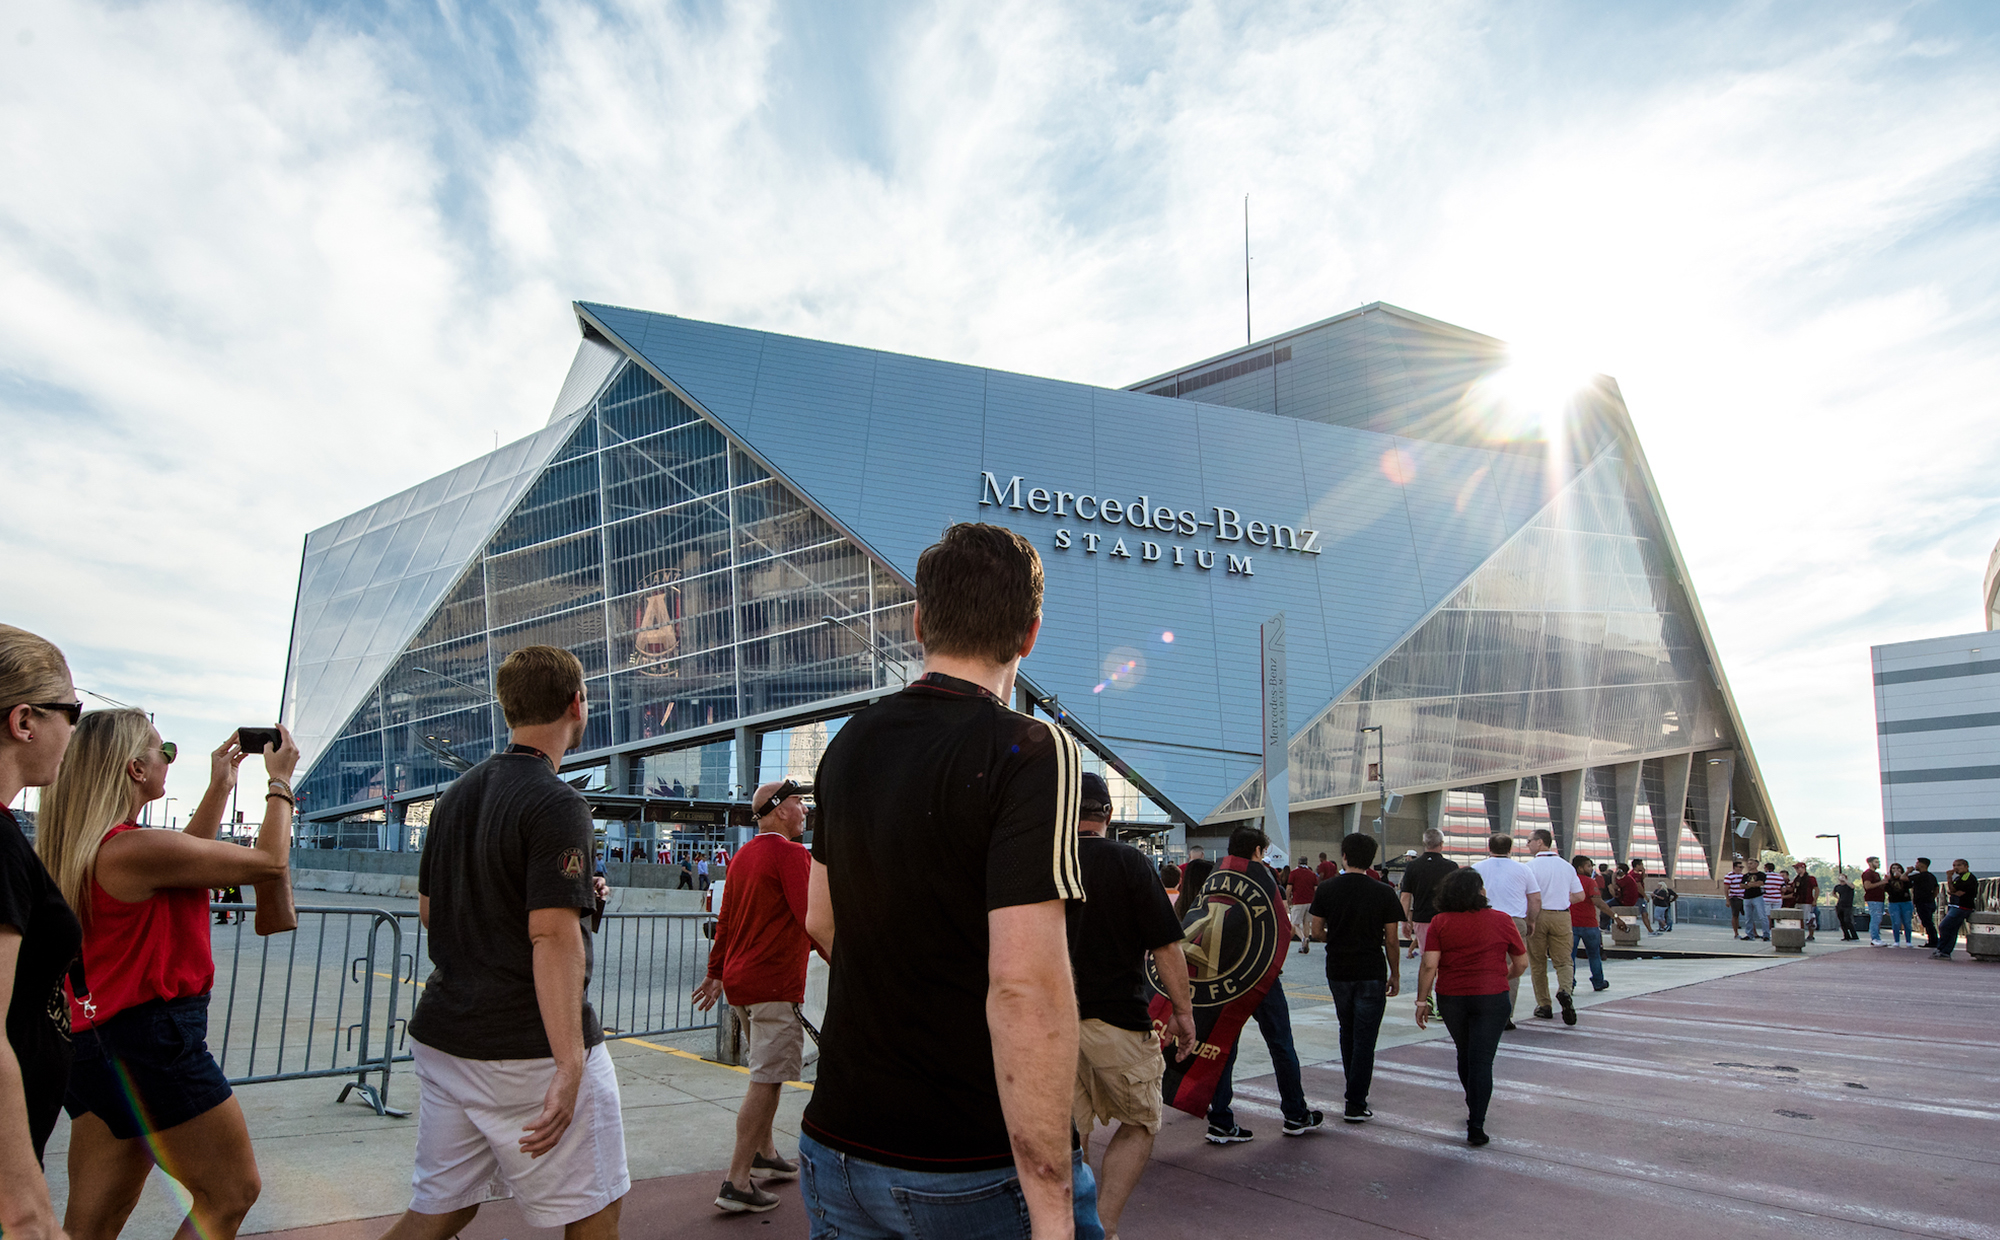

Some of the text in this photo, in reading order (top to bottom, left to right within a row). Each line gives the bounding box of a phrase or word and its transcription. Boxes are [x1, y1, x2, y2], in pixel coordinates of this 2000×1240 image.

[978, 470, 1323, 554] Mercedes-Benz
[1055, 528, 1255, 576] STADIUM
[1269, 657, 1279, 747] Mercedes-Benz
[1208, 978, 1237, 1000] FC
